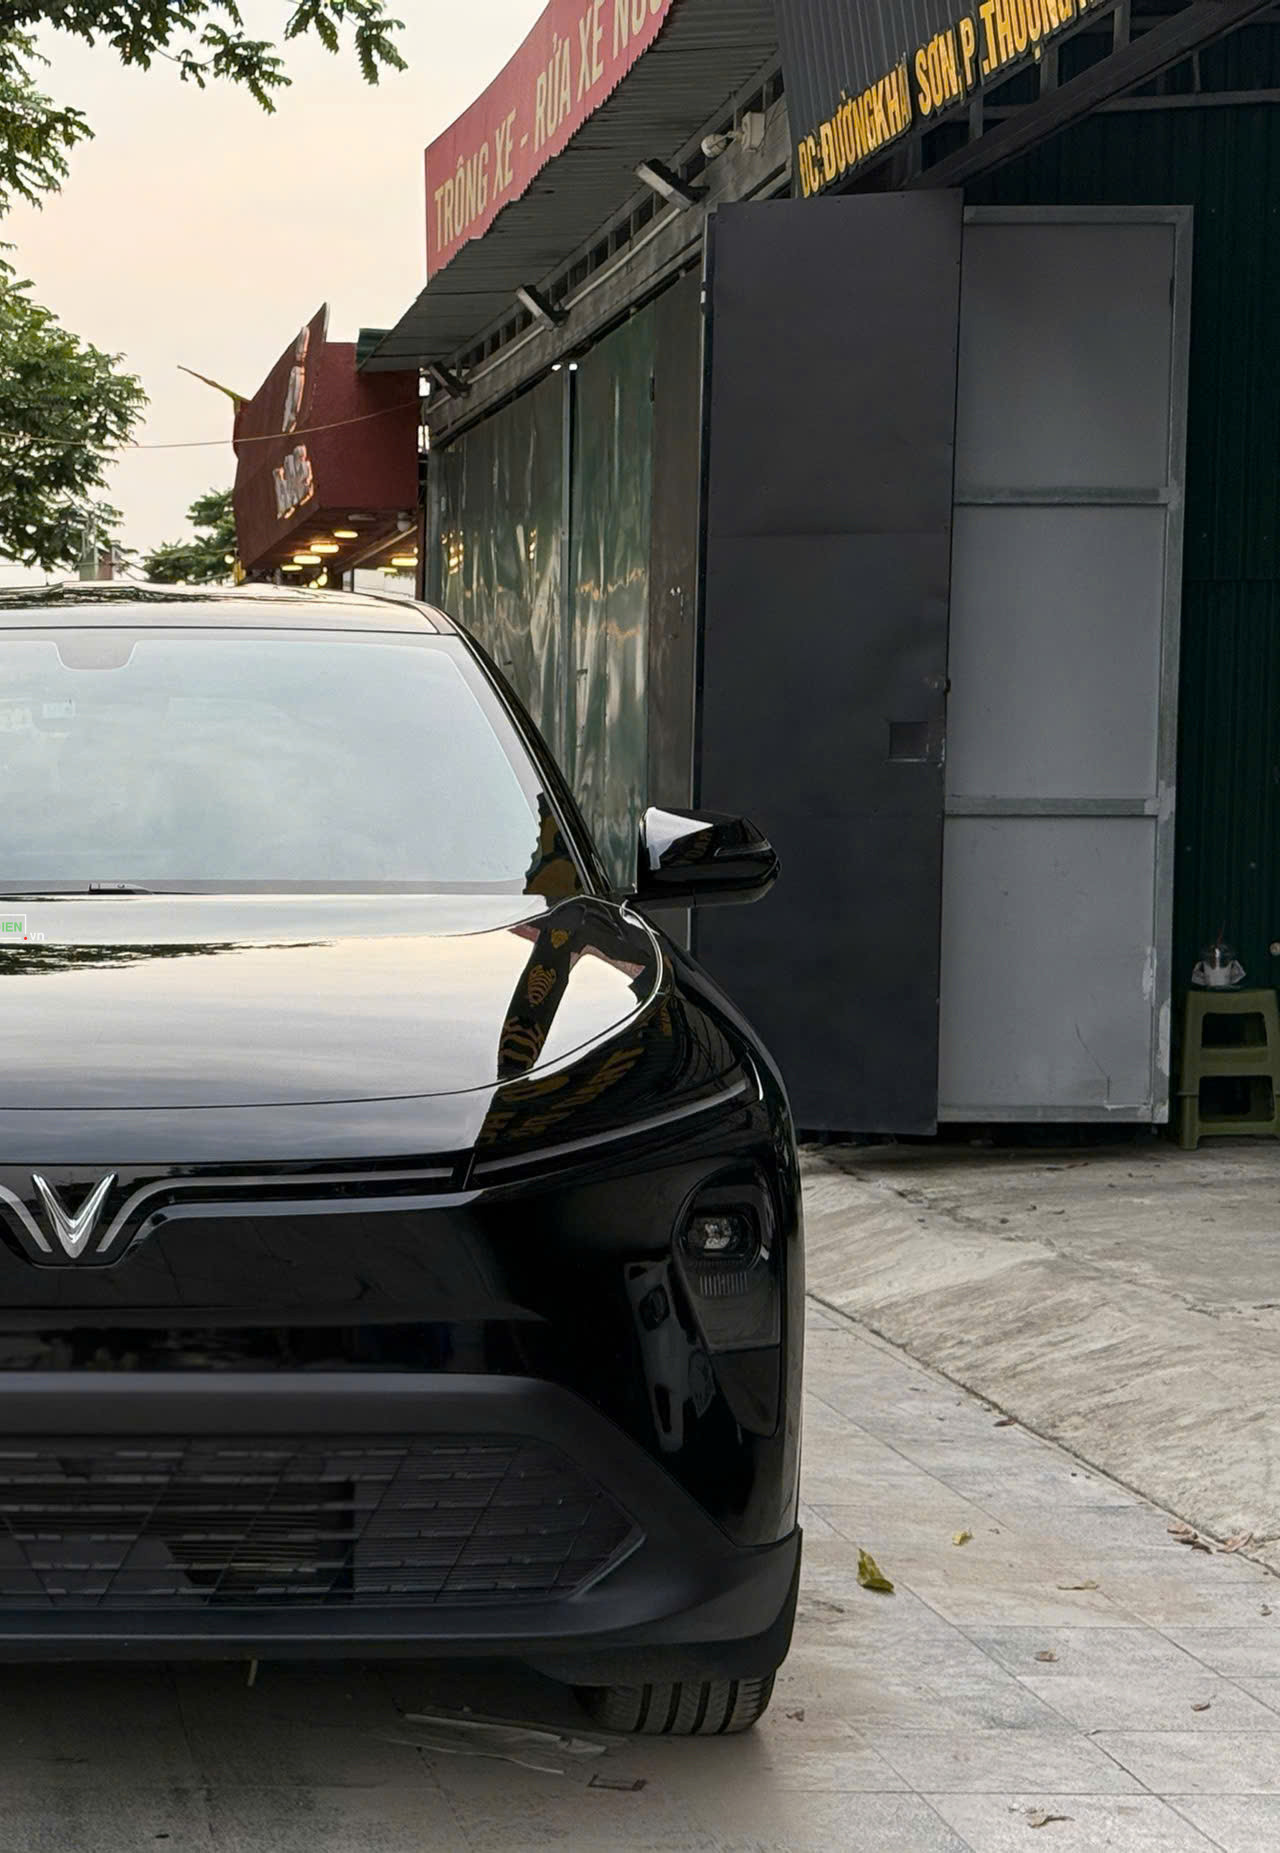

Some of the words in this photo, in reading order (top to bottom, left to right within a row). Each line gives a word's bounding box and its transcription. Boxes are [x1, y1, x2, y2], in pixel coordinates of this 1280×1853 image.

[434, 141, 489, 252] TRÔNG
[493, 107, 517, 200] XE
[534, 32, 571, 153] RỬA
[576, 0, 606, 103] XE
